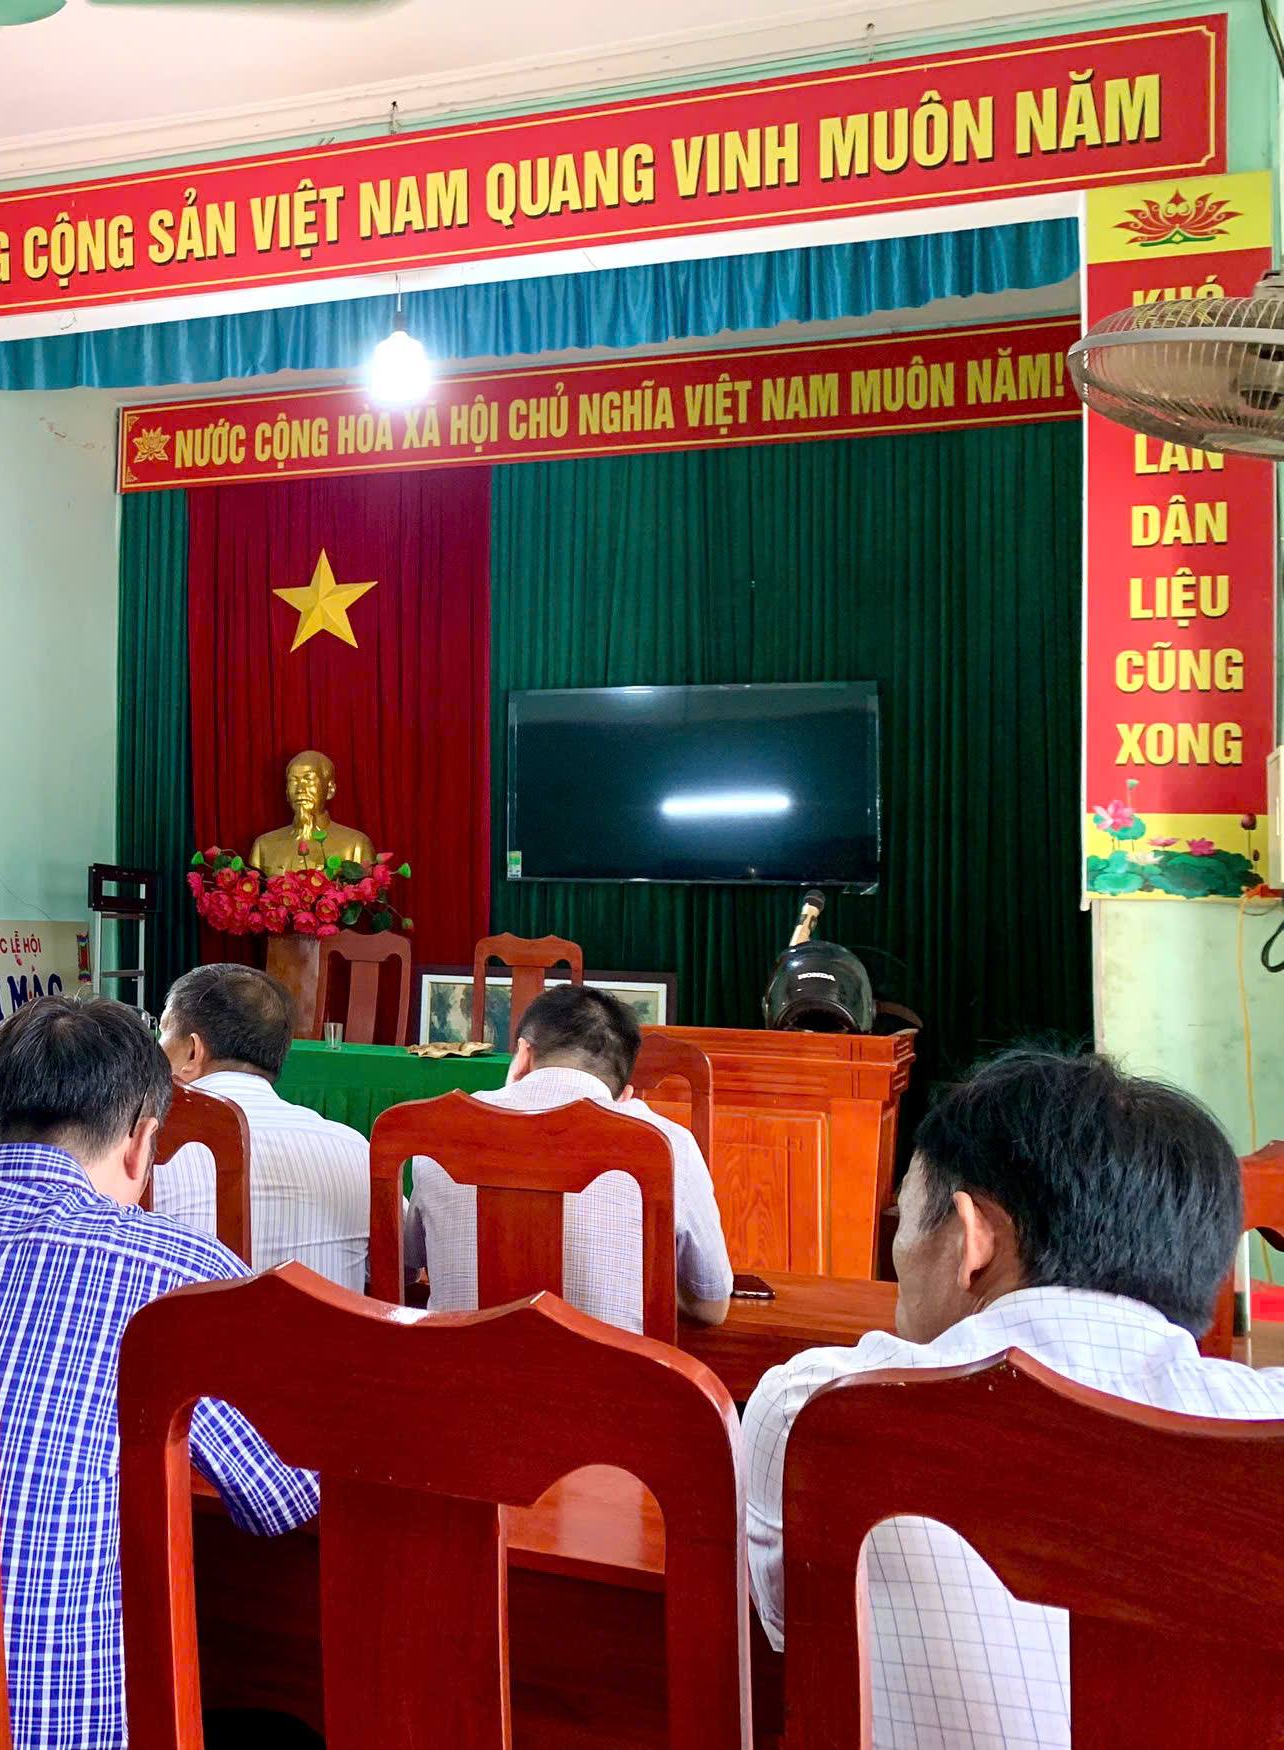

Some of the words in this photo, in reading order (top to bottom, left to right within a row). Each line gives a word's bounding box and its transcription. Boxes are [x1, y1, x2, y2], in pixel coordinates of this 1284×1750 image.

[23, 204, 135, 290] CỘNG
[149, 187, 237, 264] SẢN
[251, 180, 345, 260] VIỆT
[359, 167, 468, 236] NAM
[485, 143, 655, 228] QUANG
[671, 121, 799, 198] VINH
[820, 92, 994, 179] MUÔN
[1016, 69, 1161, 156] NĂM
[174, 418, 246, 469] NƯỚC
[254, 412, 329, 470] CỘNG
[450, 394, 498, 453] HỘI
[508, 381, 568, 441] CHỦ
[578, 379, 674, 436] NGHĨA
[683, 372, 752, 434] VIỆT
[761, 373, 839, 421] NAM
[850, 355, 955, 415] MUÔN
[966, 347, 1065, 405] NĂM!
[1131, 494, 1228, 547] DÂN
[1129, 567, 1229, 627] LIỆU
[1115, 641, 1244, 692] CŨNG
[1115, 722, 1243, 765] XONG
[10, 930, 21, 954] LỄ
[23, 933, 42, 957] HỘI
